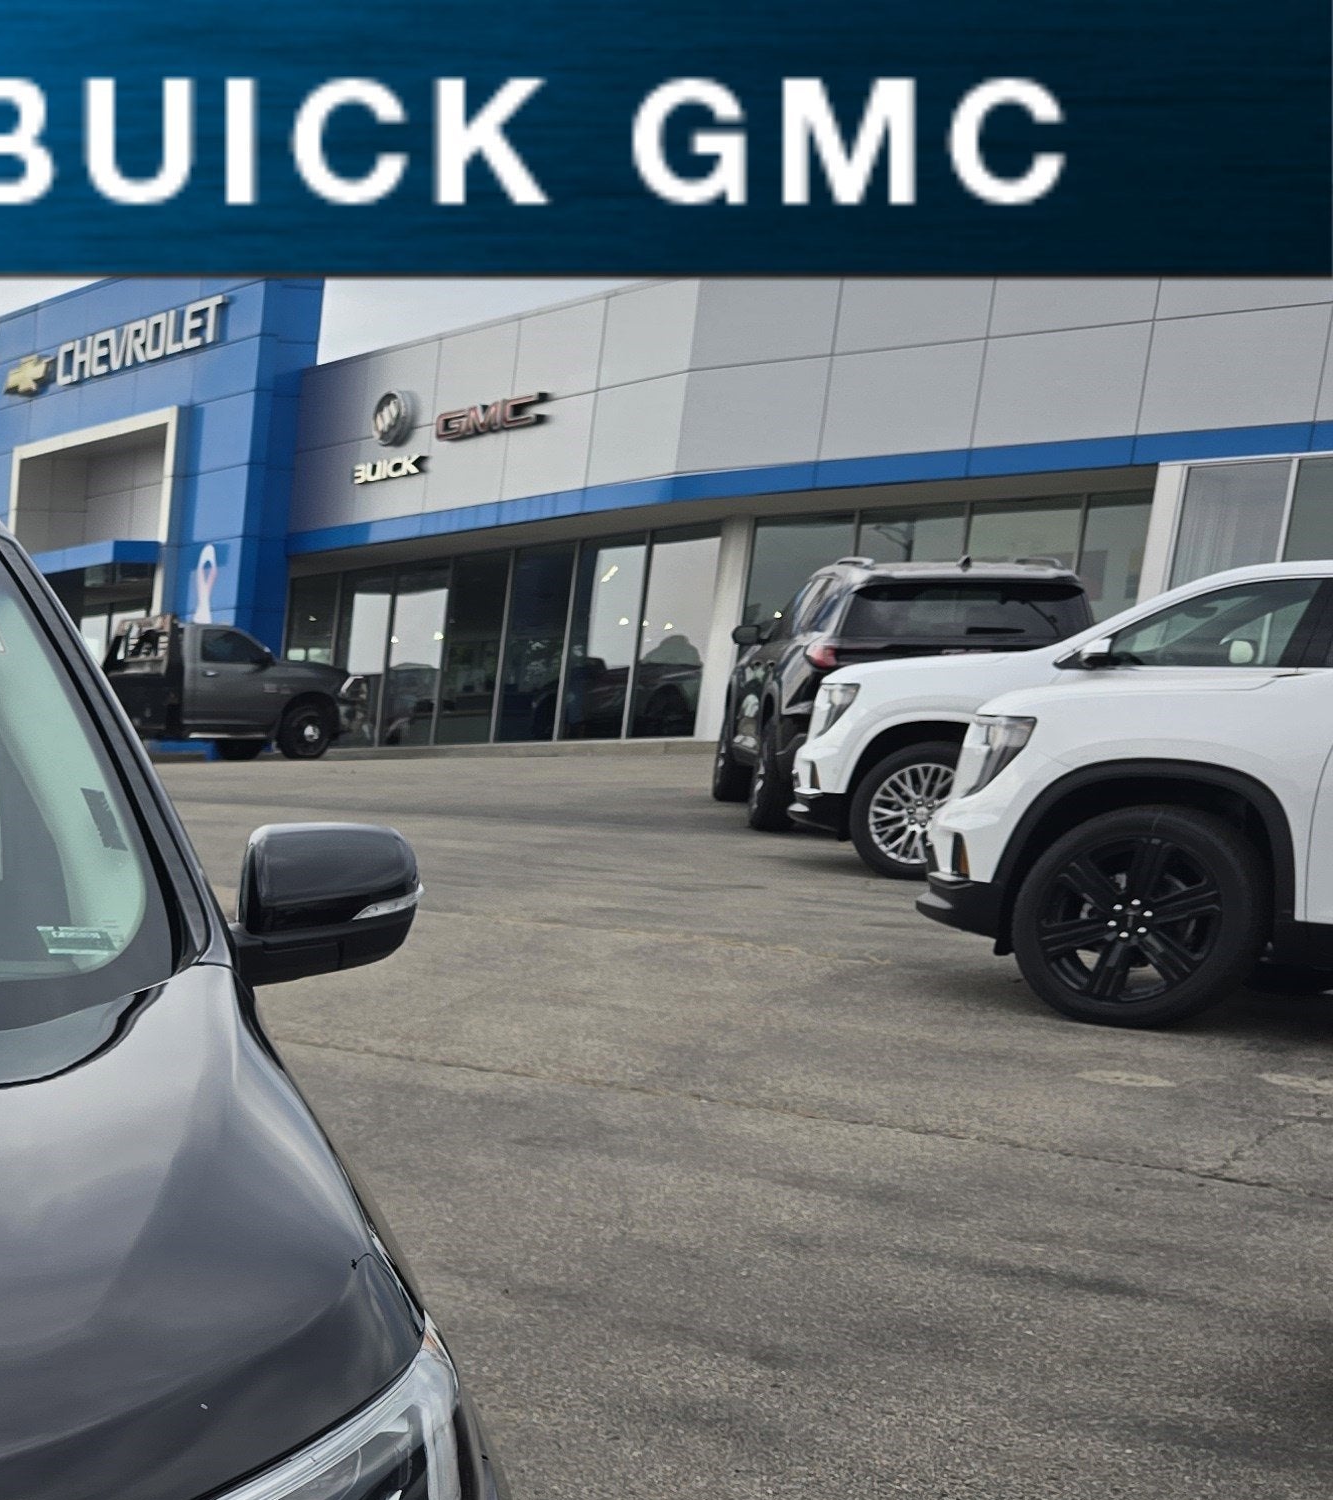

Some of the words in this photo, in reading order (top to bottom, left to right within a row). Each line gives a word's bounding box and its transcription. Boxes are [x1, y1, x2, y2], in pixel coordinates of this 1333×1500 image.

[56, 294, 227, 386] CHEVROLET
[435, 394, 540, 442] GMC
[353, 452, 423, 484] BUICK
